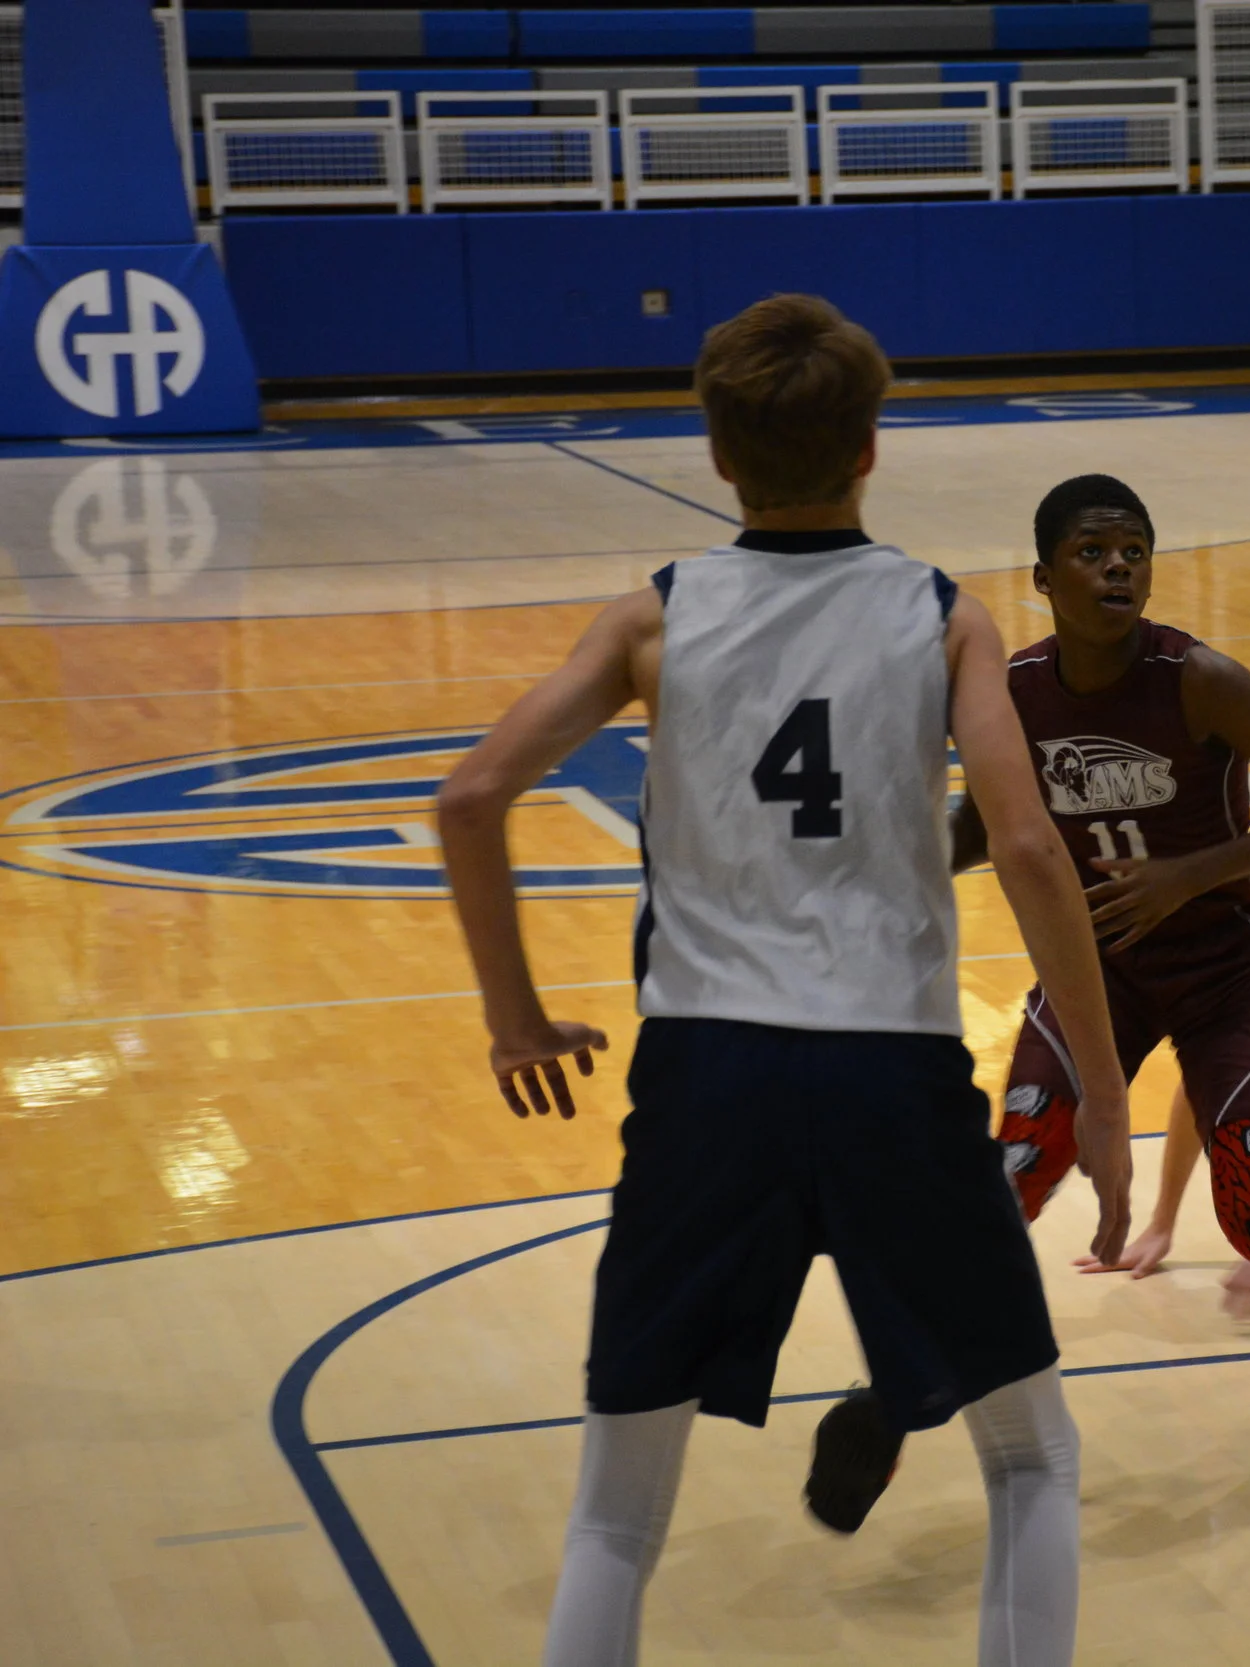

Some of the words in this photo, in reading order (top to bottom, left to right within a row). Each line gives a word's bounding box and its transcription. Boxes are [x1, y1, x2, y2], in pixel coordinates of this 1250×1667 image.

[751, 698, 842, 838] 4
[1042, 746, 1177, 814] RAMS
[1087, 820, 1148, 861] 11
